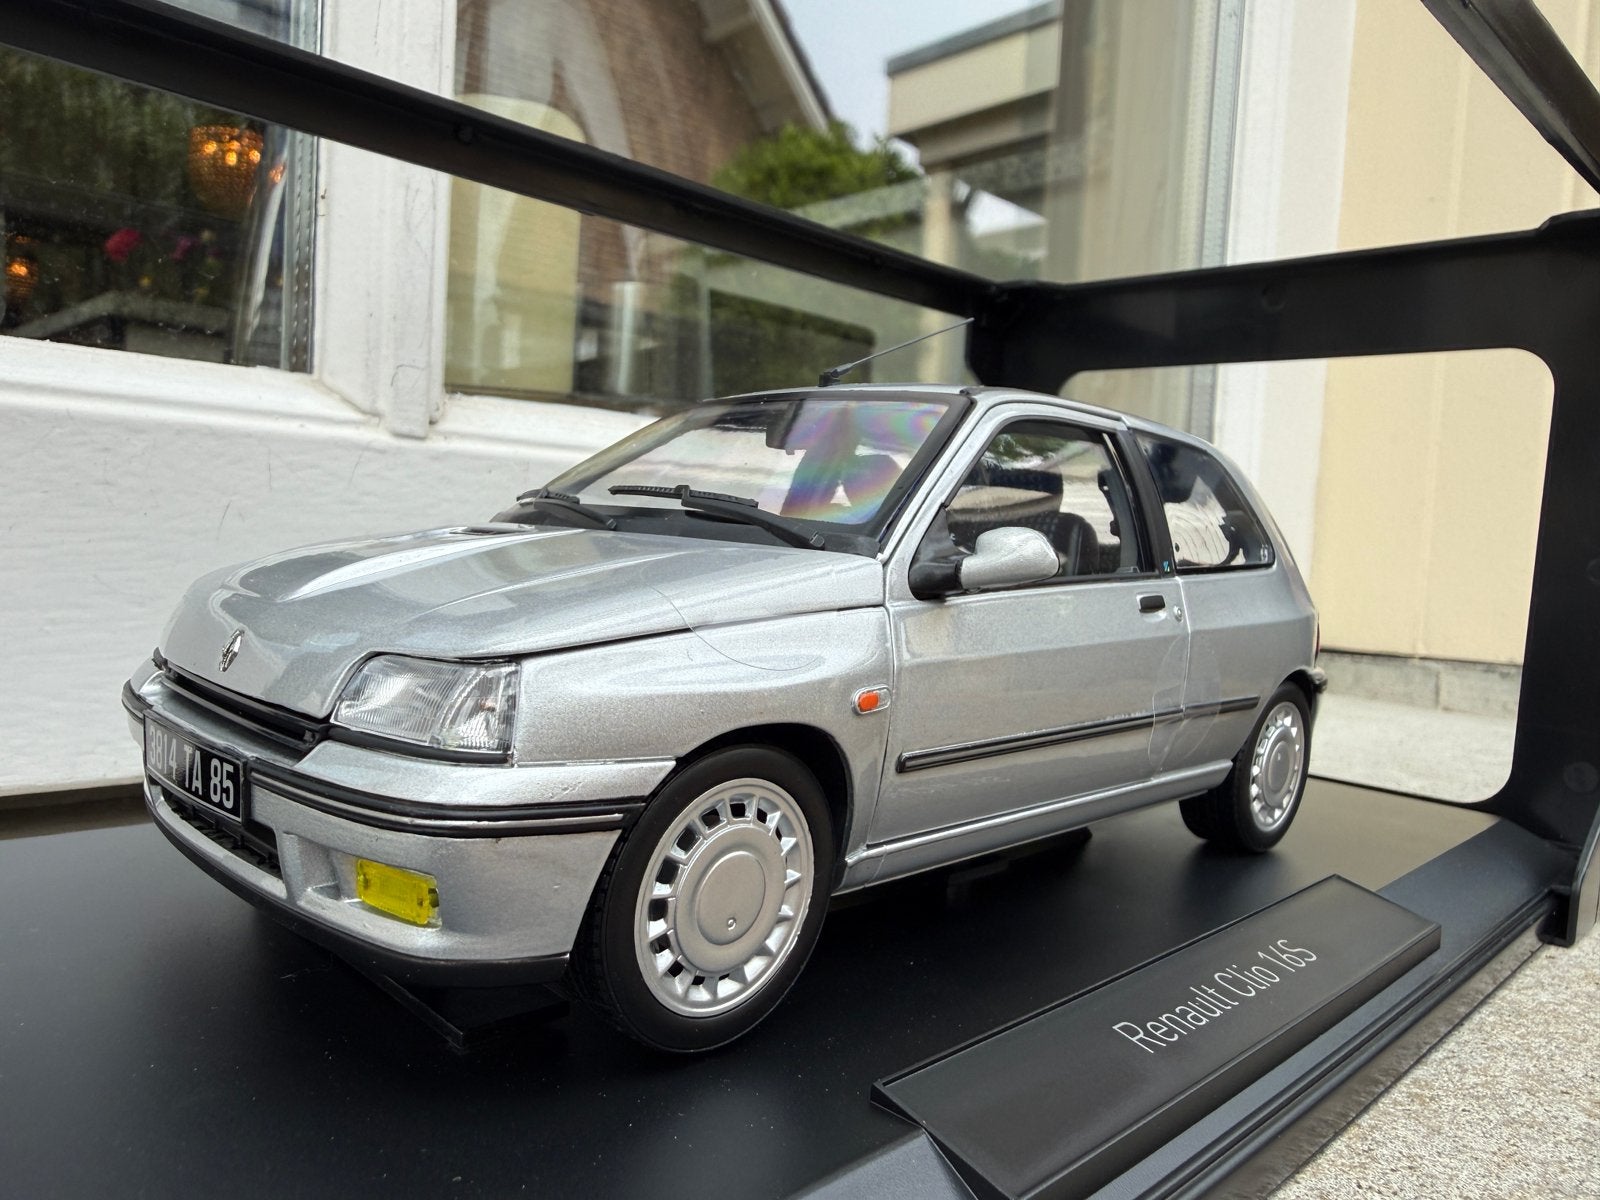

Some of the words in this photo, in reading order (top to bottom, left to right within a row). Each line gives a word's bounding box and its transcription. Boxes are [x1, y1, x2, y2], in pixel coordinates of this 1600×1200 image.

[148, 724, 178, 781] 3814
[183, 744, 203, 796] TA
[209, 758, 234, 809] 85
[1112, 985, 1240, 1054] Renault
[1213, 964, 1281, 998] Clio
[1257, 939, 1319, 973] 16S
